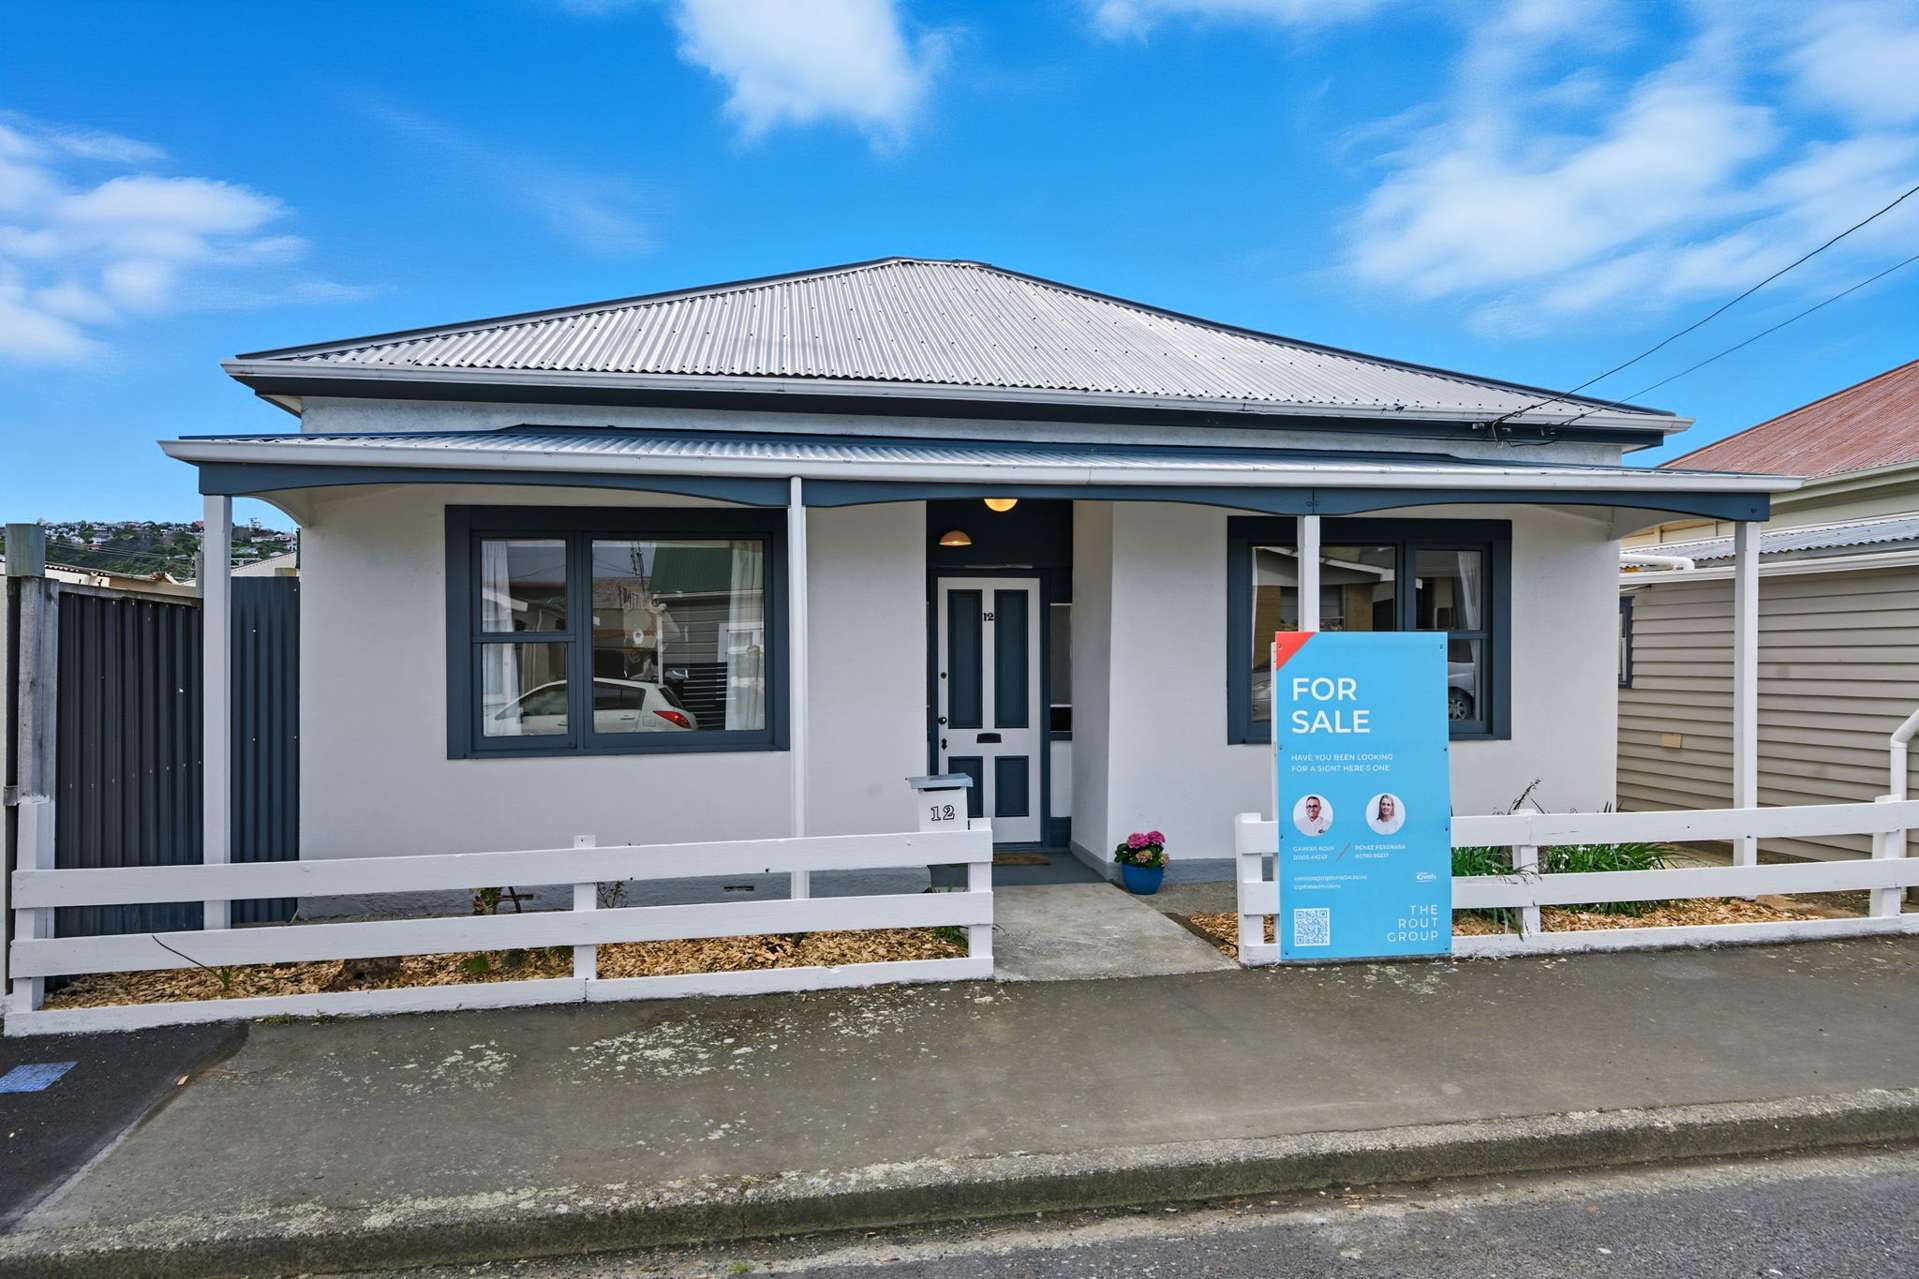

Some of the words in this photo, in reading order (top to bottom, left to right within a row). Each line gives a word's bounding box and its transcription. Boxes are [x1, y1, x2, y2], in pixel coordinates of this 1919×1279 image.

[983, 612, 994, 622] 12
[1292, 677, 1357, 702] FOR
[1291, 710, 1371, 735] SALE
[1291, 753, 1313, 762] HAVE
[1315, 753, 1332, 761] YOU
[1333, 753, 1355, 761] BEEN
[1357, 752, 1393, 761] LOOKING
[1291, 765, 1308, 773] FOR
[930, 804, 956, 821] 12
[1408, 904, 1439, 916] THE
[1397, 917, 1438, 929] ROUT
[1386, 930, 1439, 943] GROUP
